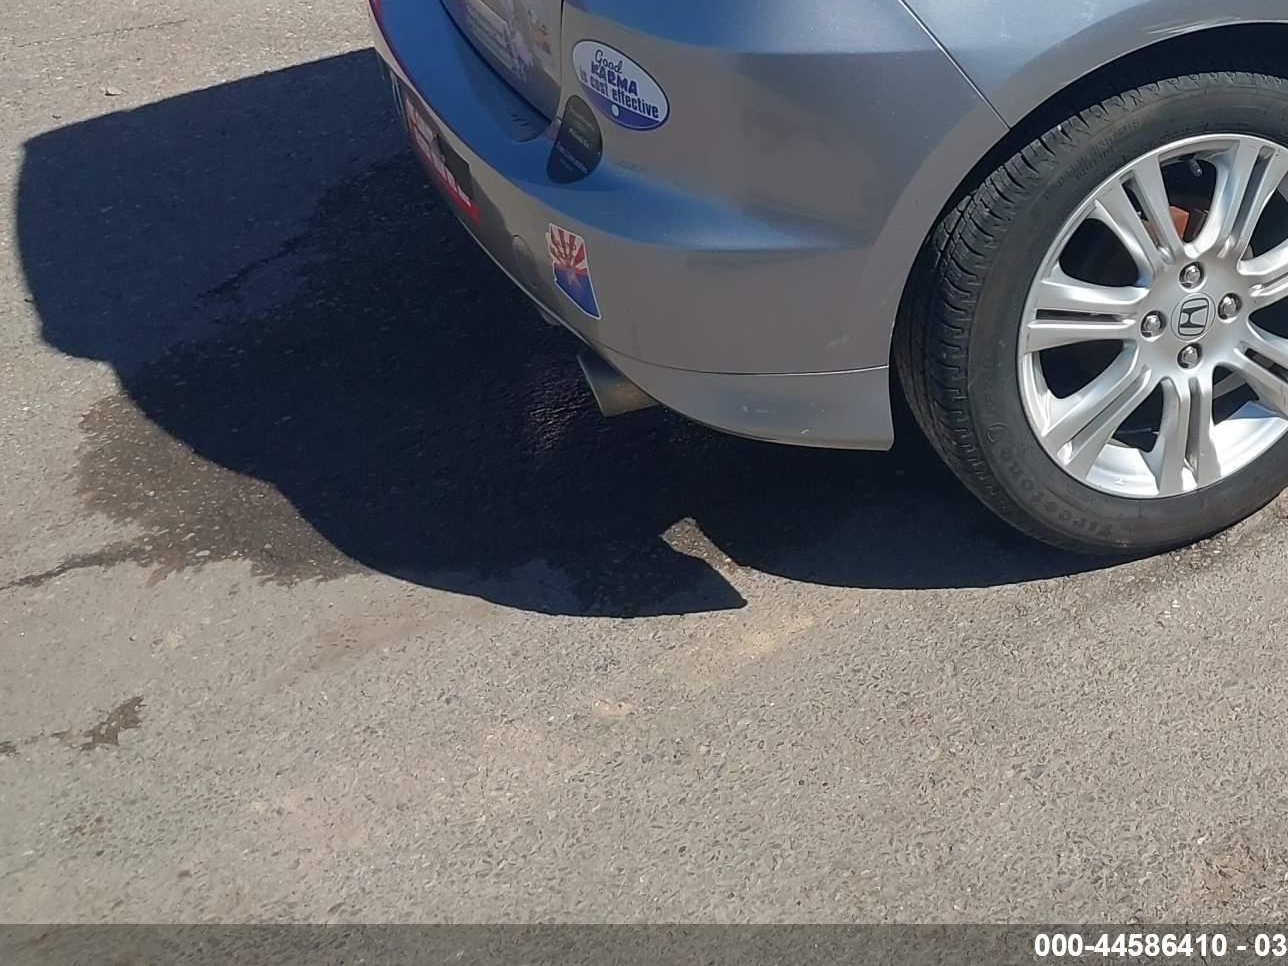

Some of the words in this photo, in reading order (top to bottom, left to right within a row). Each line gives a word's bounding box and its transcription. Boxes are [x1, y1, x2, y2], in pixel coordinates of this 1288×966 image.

[594, 49, 623, 74] Good
[591, 60, 638, 97] KARMA
[611, 88, 659, 119] effective
